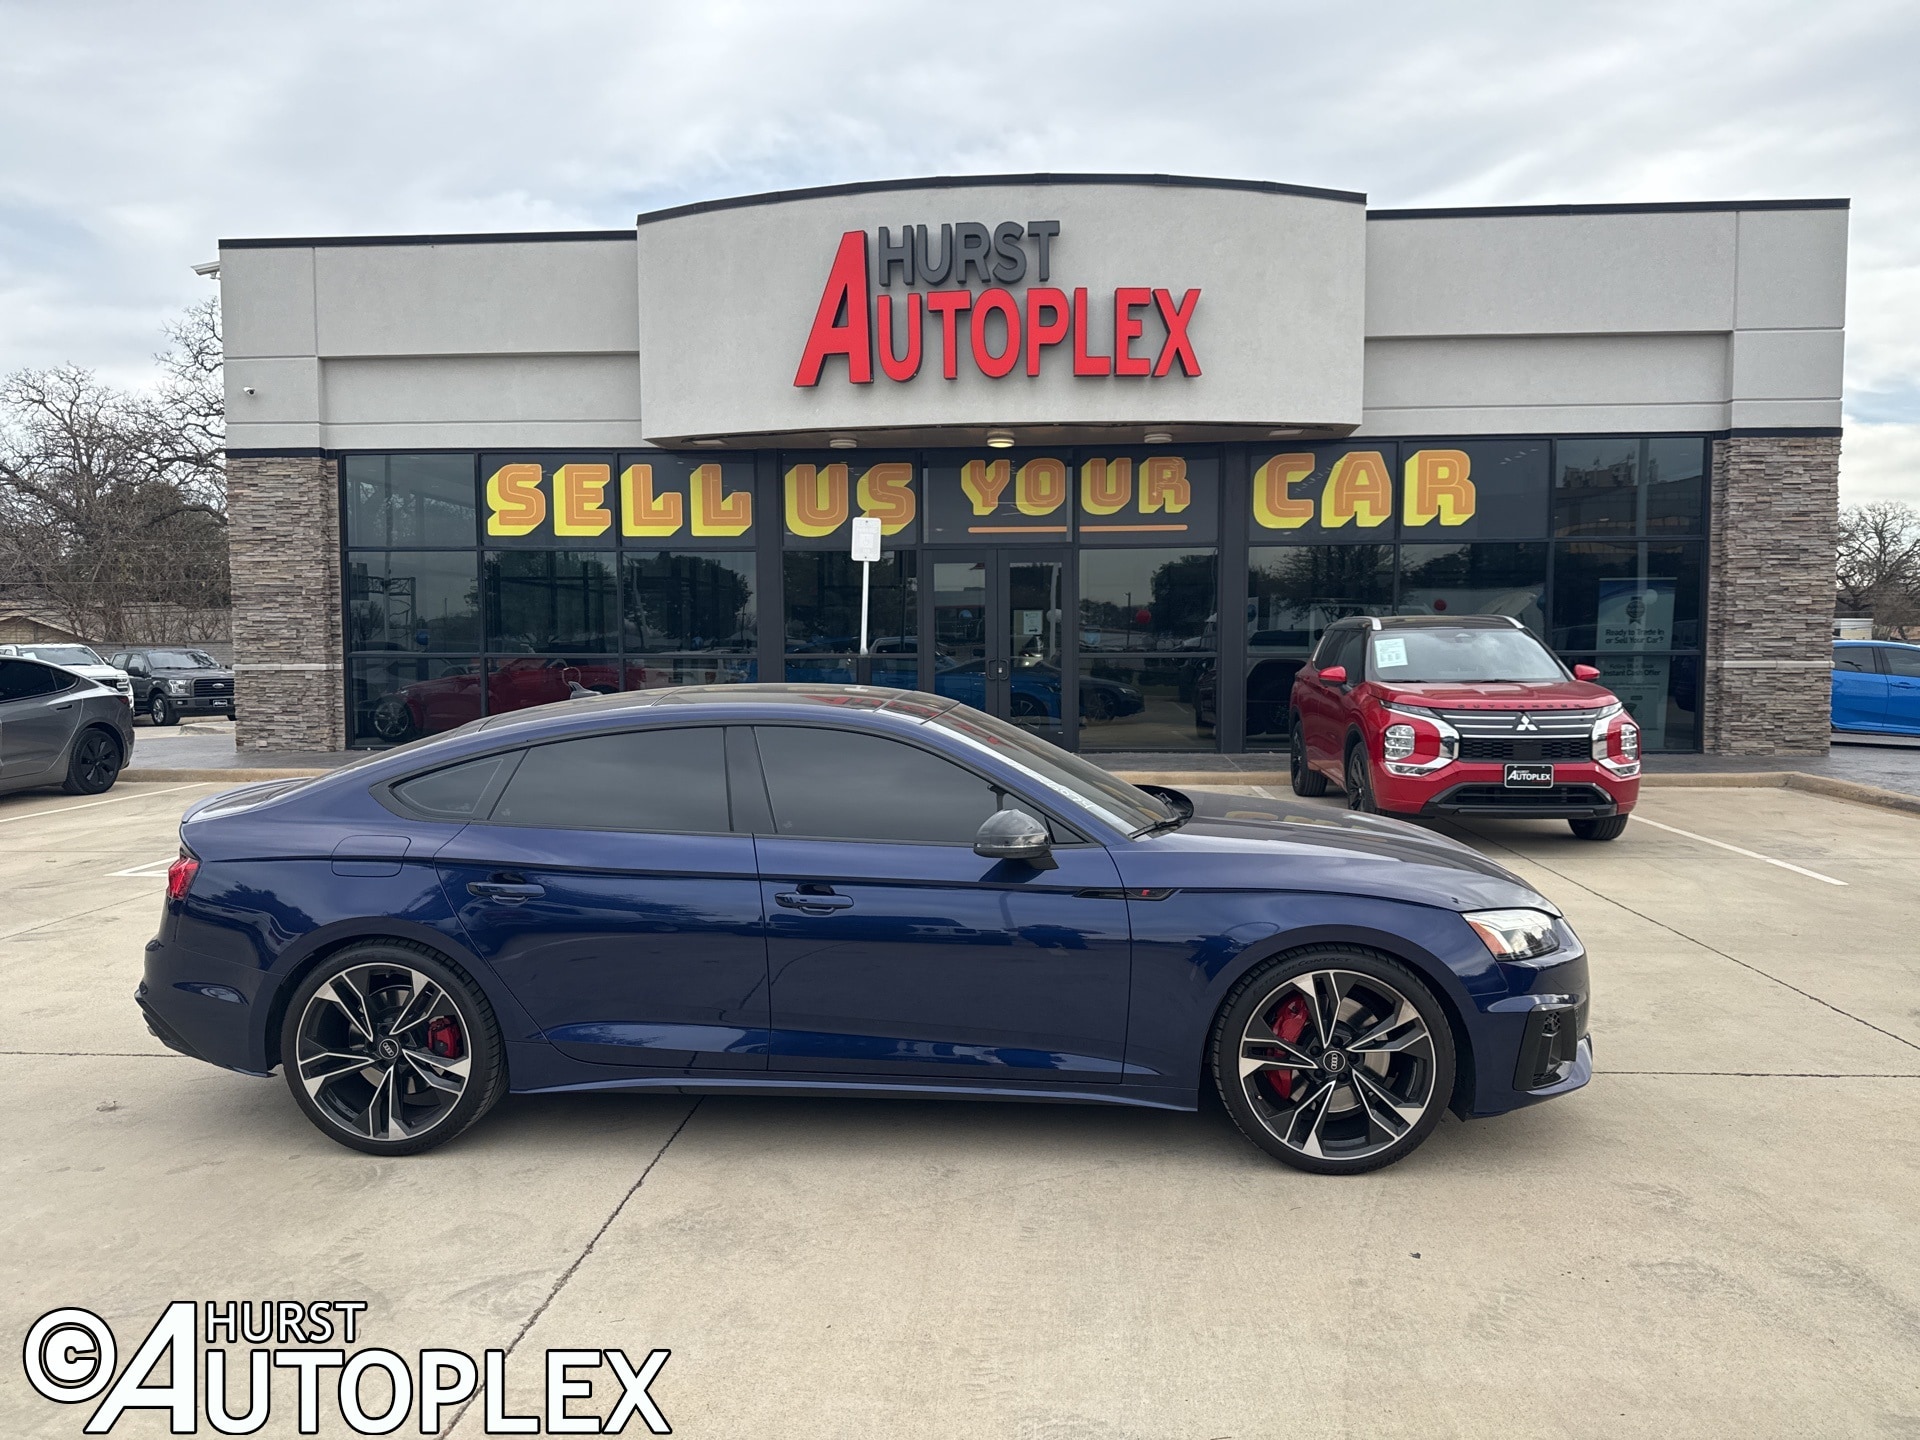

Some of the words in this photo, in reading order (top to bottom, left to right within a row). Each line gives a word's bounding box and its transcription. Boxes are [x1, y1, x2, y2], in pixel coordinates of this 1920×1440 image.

[878, 220, 1060, 287] HURST
[793, 229, 1203, 388] AUTOPLEX
[486, 463, 753, 537] SELL
[784, 462, 916, 538] US
[960, 456, 1191, 517] YOUR
[1252, 449, 1477, 530] CAR
[1507, 769, 1551, 781] AUTOPLEX
